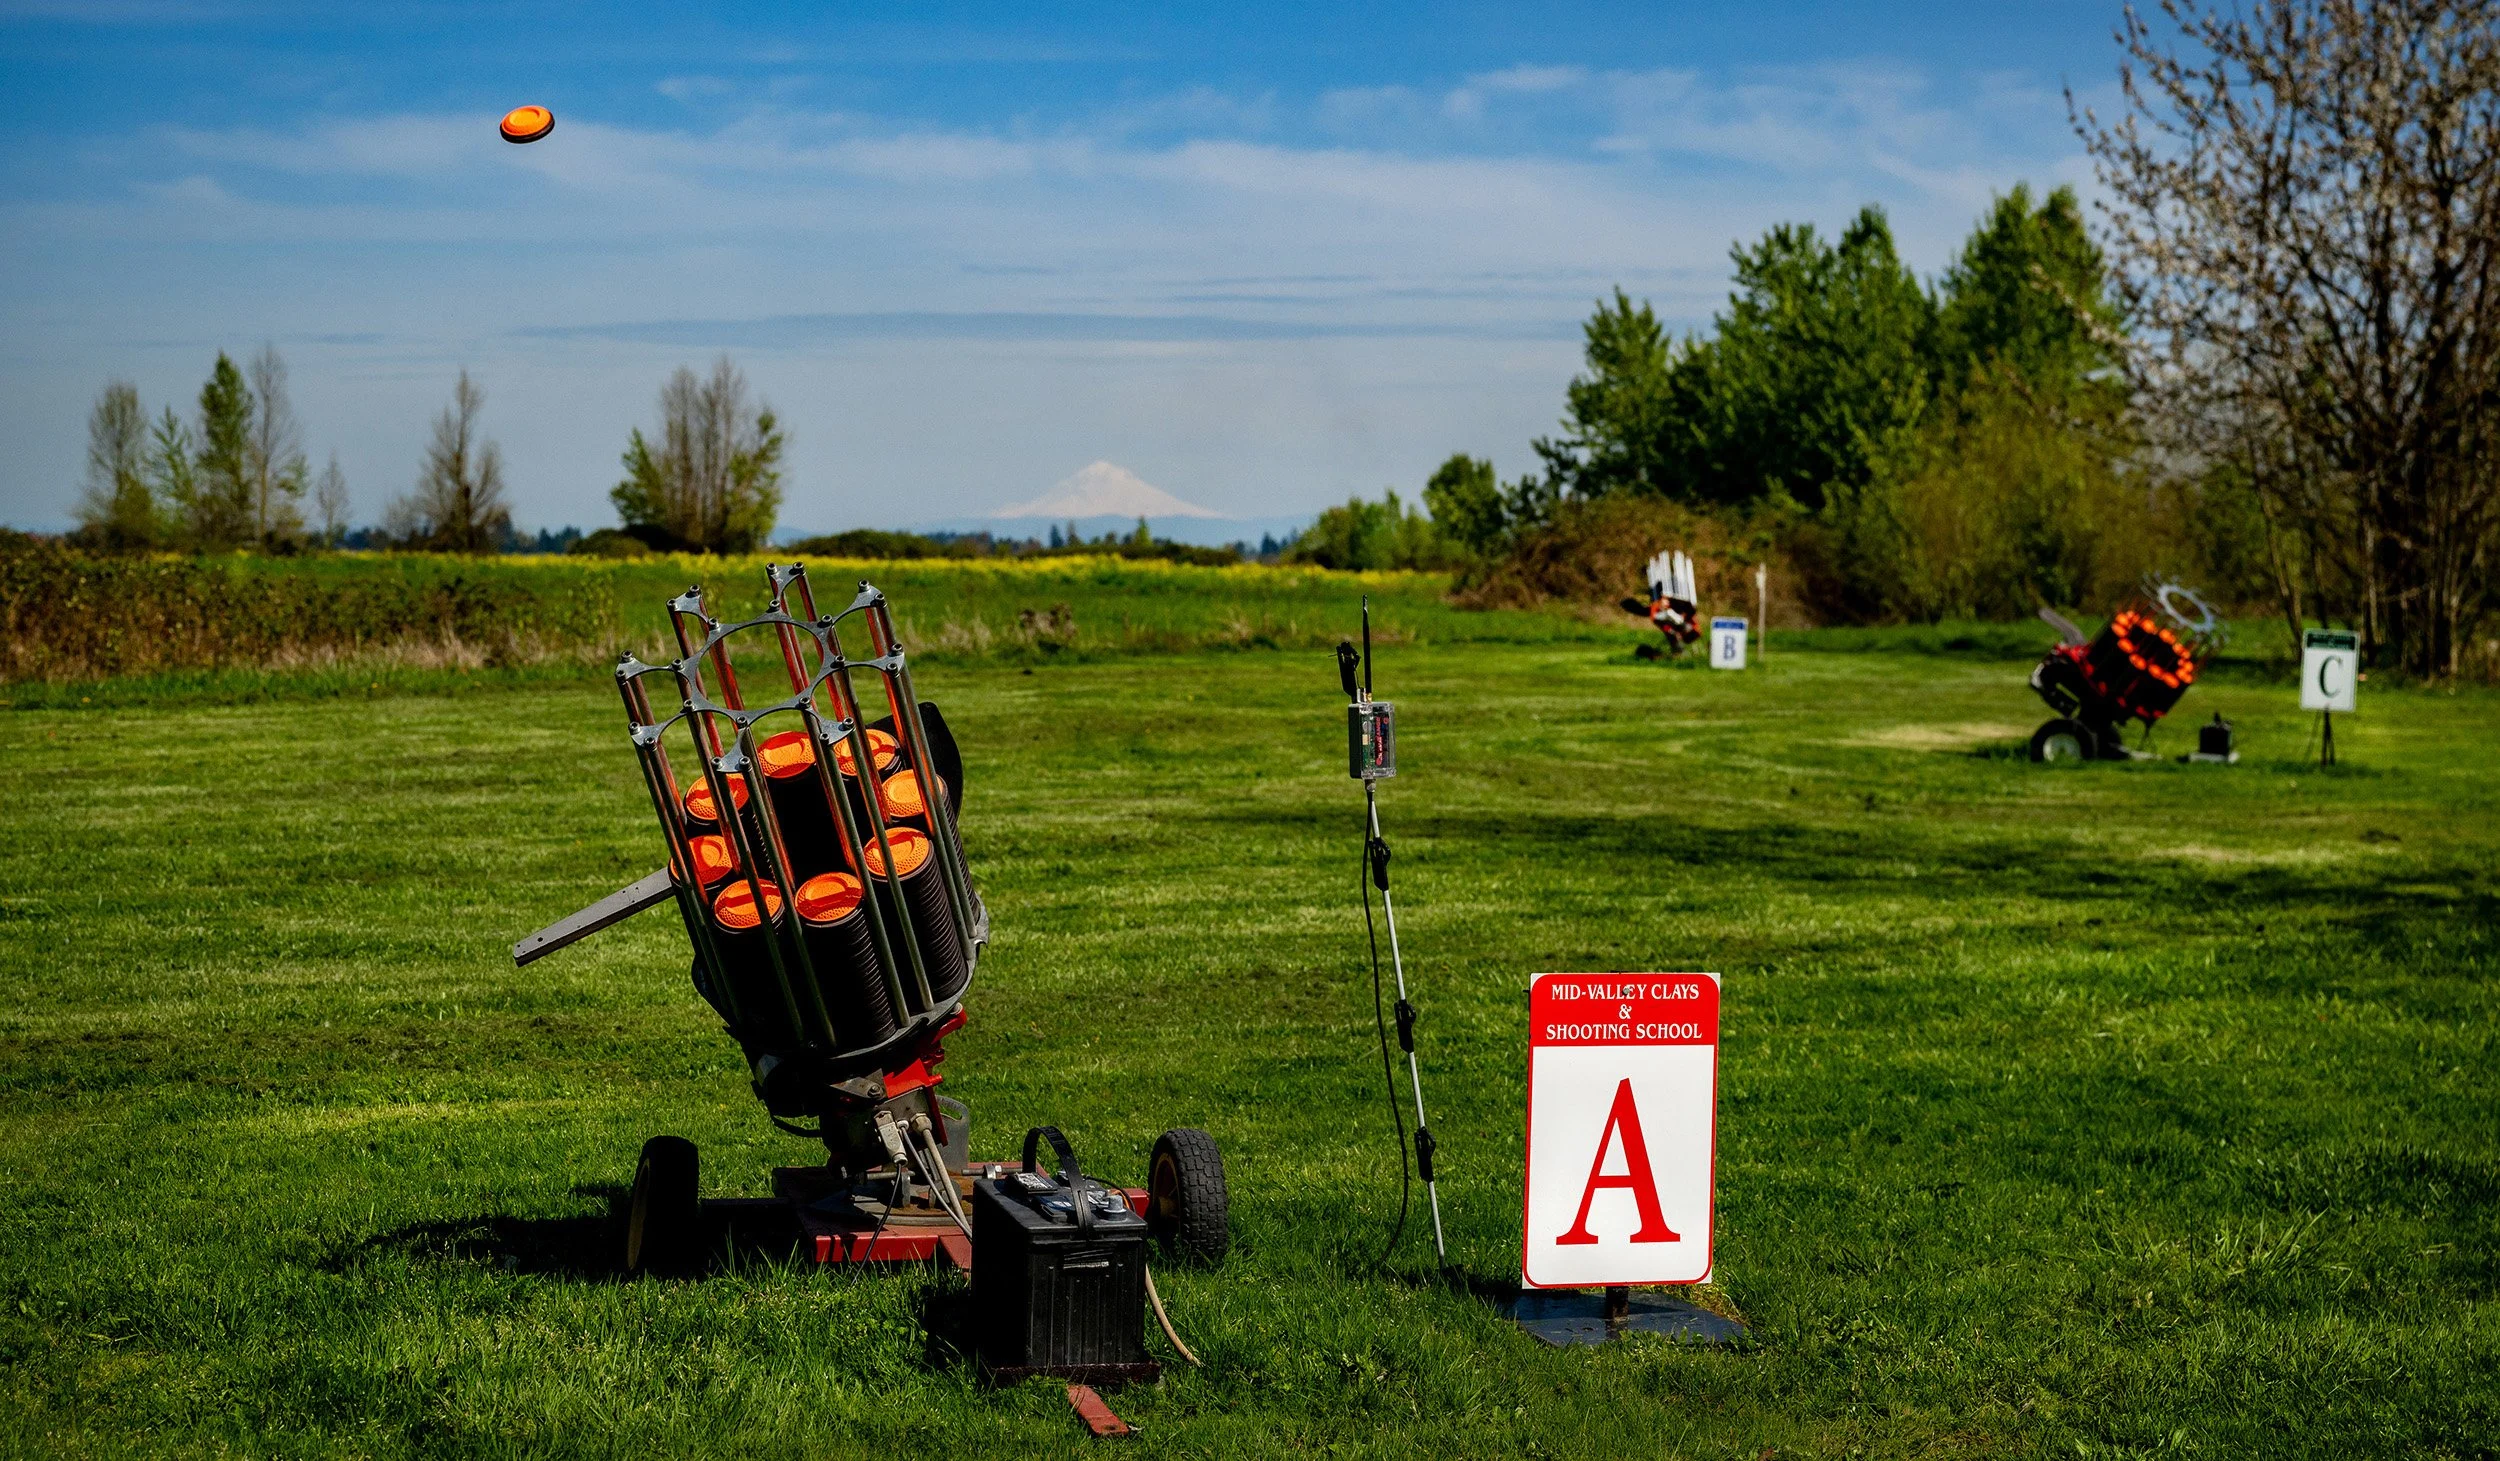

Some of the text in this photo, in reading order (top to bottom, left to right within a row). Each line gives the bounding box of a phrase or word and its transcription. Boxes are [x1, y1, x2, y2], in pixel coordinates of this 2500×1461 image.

[1723, 636, 1736, 659] B
[2319, 656, 2342, 697] C
[1551, 983, 1700, 1000] MID-VALLEY CLAYS
[1618, 1003, 1633, 1020] &
[1546, 1023, 1703, 1040] SHOOTING SCHOOL
[1556, 1077, 1680, 1245] A
